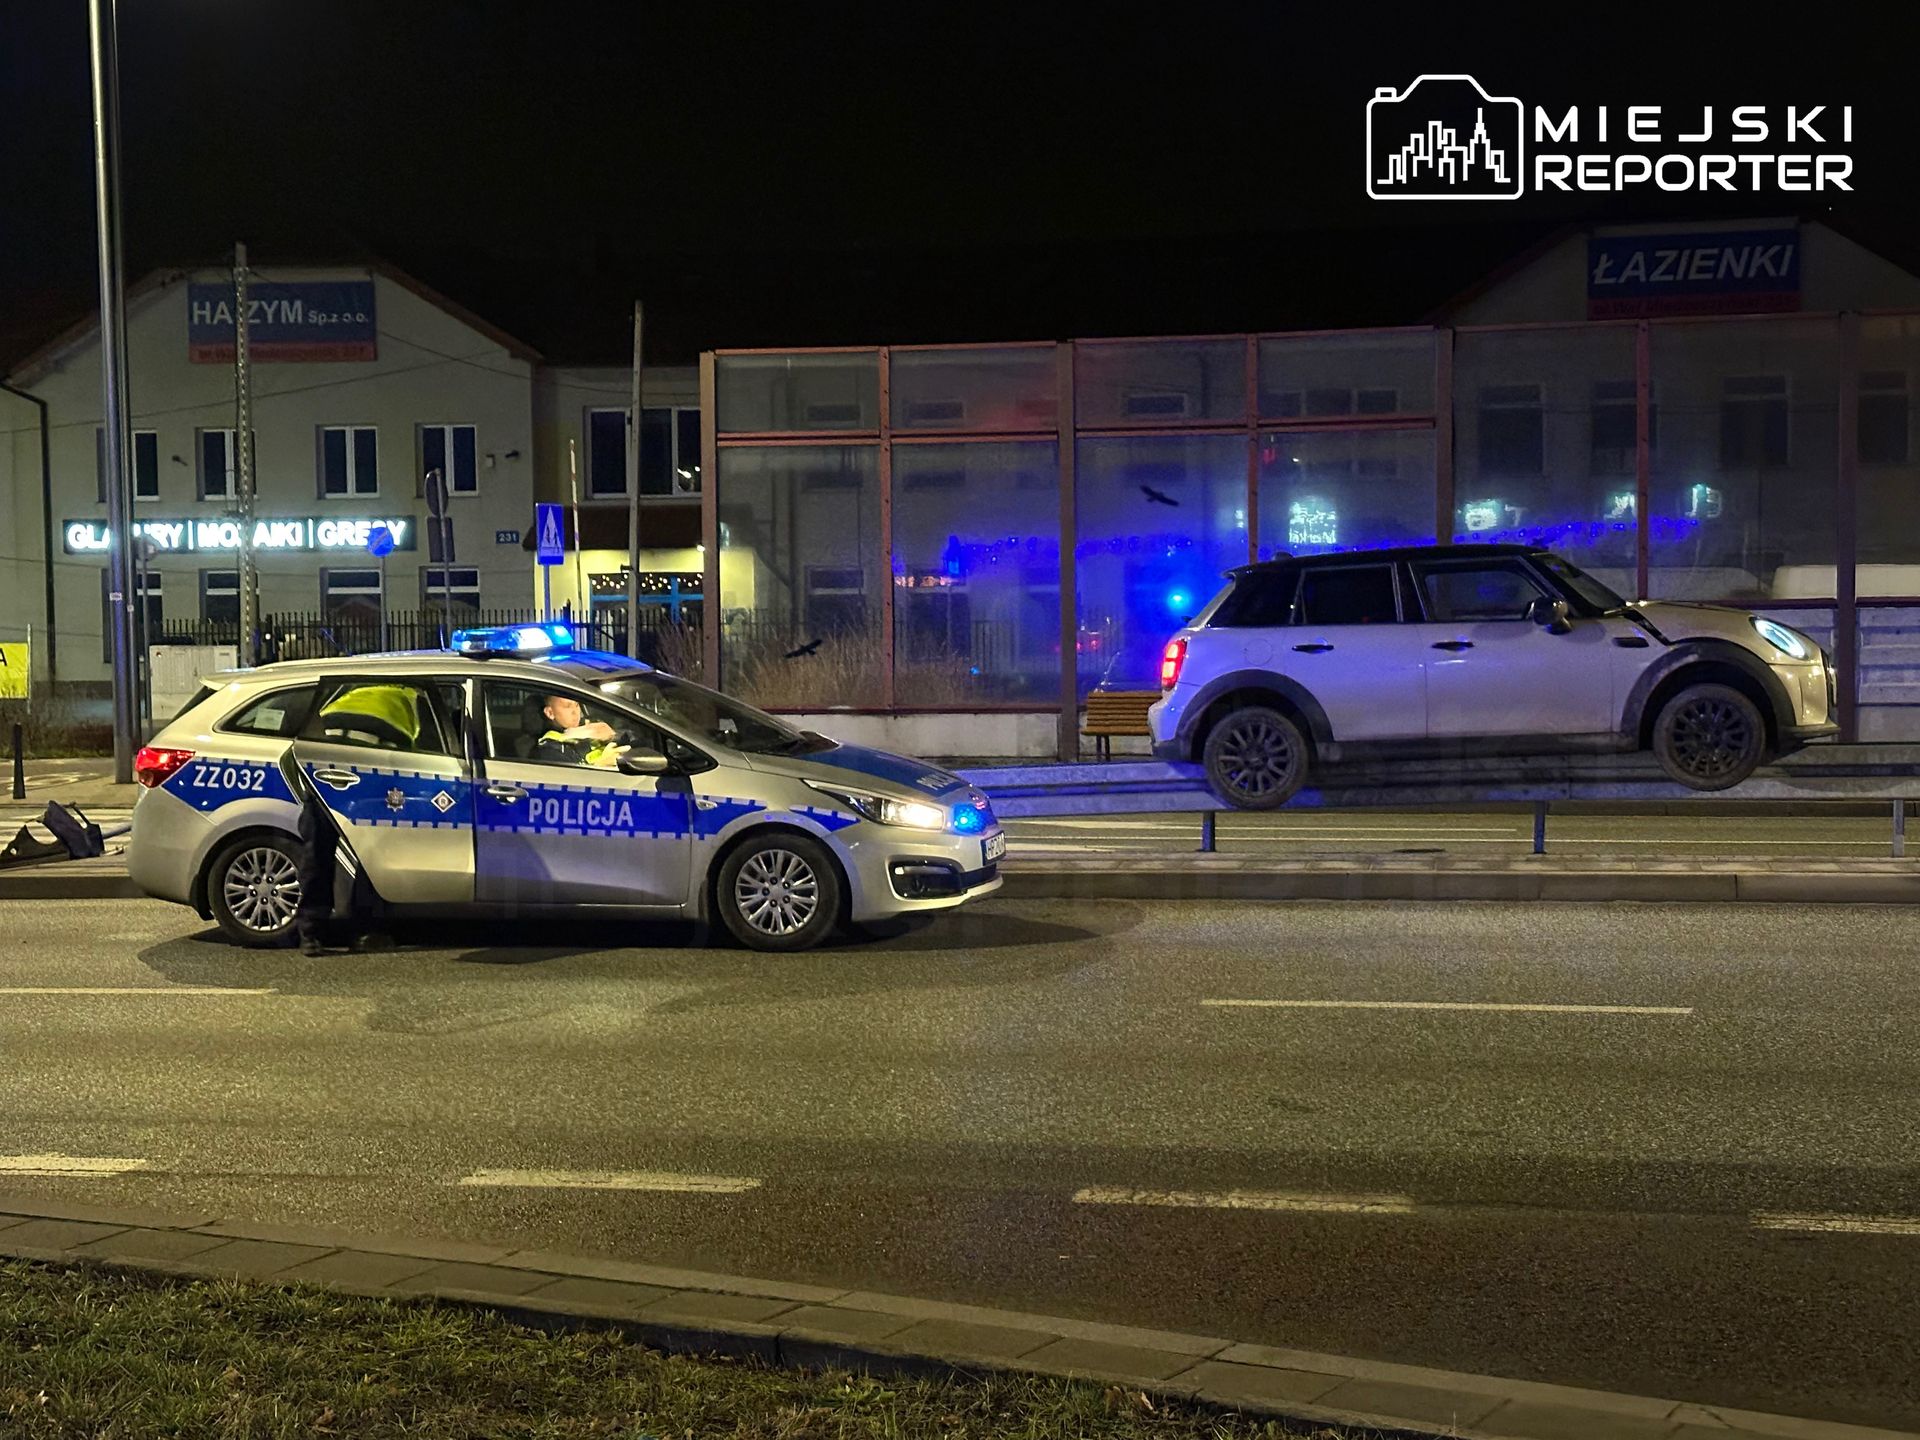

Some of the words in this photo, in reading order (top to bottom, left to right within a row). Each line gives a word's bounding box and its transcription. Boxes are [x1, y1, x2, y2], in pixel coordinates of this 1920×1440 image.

[1592, 244, 1794, 285] ŁAZIENKI
[197, 522, 303, 548] MOAIKI
[498, 533, 517, 542] 231
[193, 765, 266, 791] ZZ032
[528, 798, 634, 827] POLICJA
